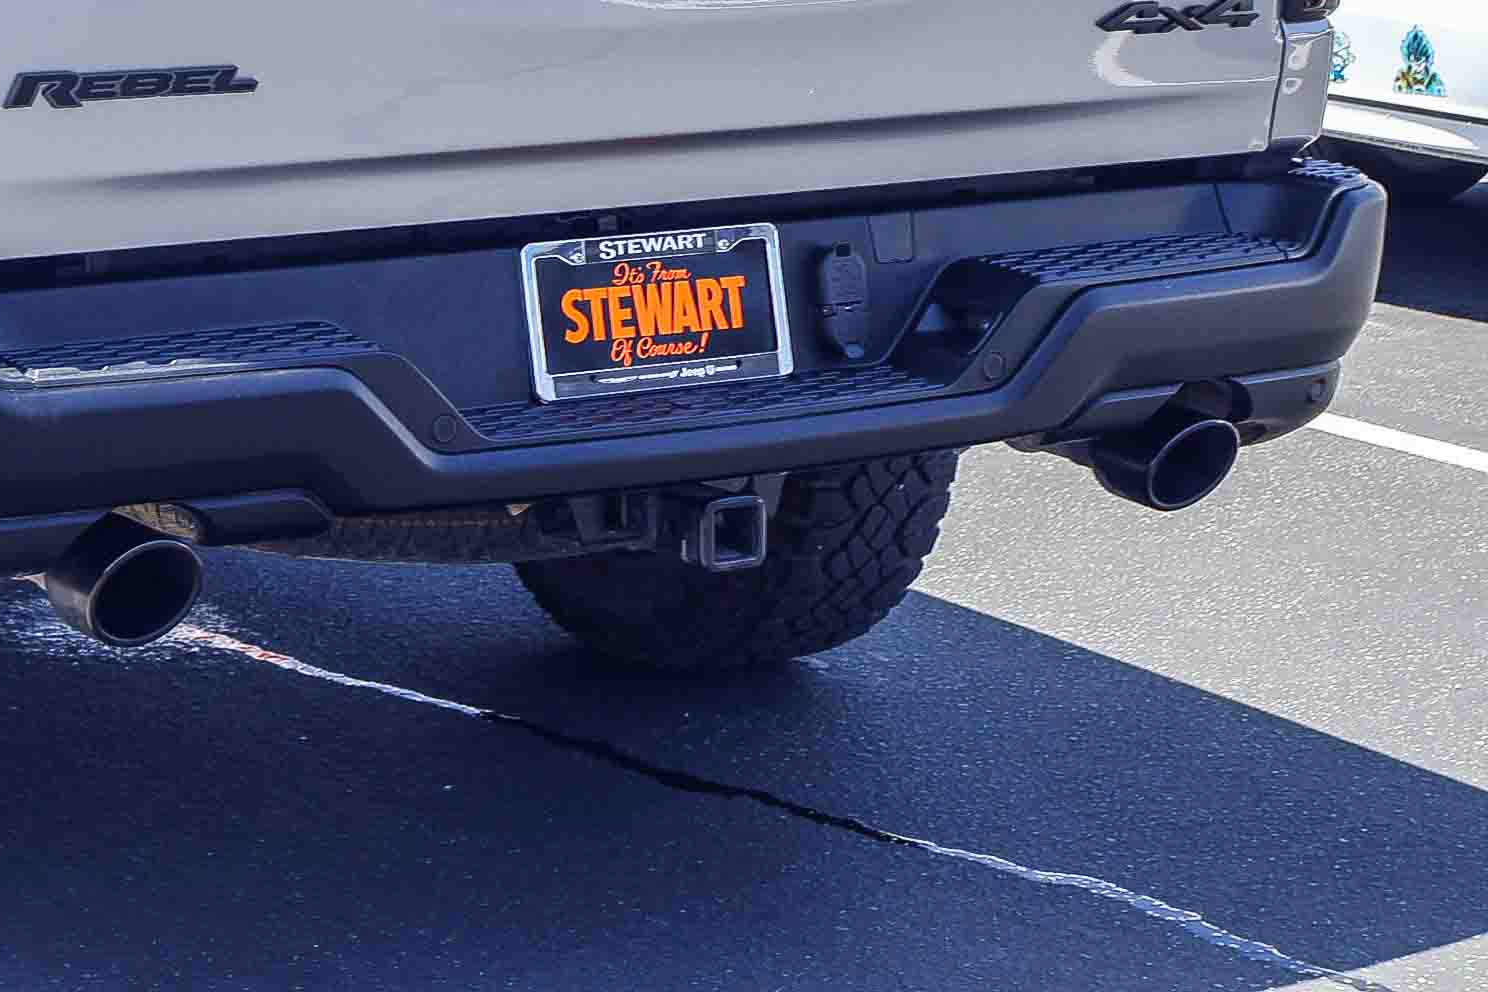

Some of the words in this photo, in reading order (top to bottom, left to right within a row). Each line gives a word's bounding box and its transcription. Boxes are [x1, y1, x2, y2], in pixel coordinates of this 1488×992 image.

[1, 64, 259, 110] REBEL
[598, 233, 707, 260] STEWART
[612, 262, 645, 286] It's
[645, 261, 692, 284] From
[560, 275, 746, 344] STEWART
[610, 338, 634, 367] Of
